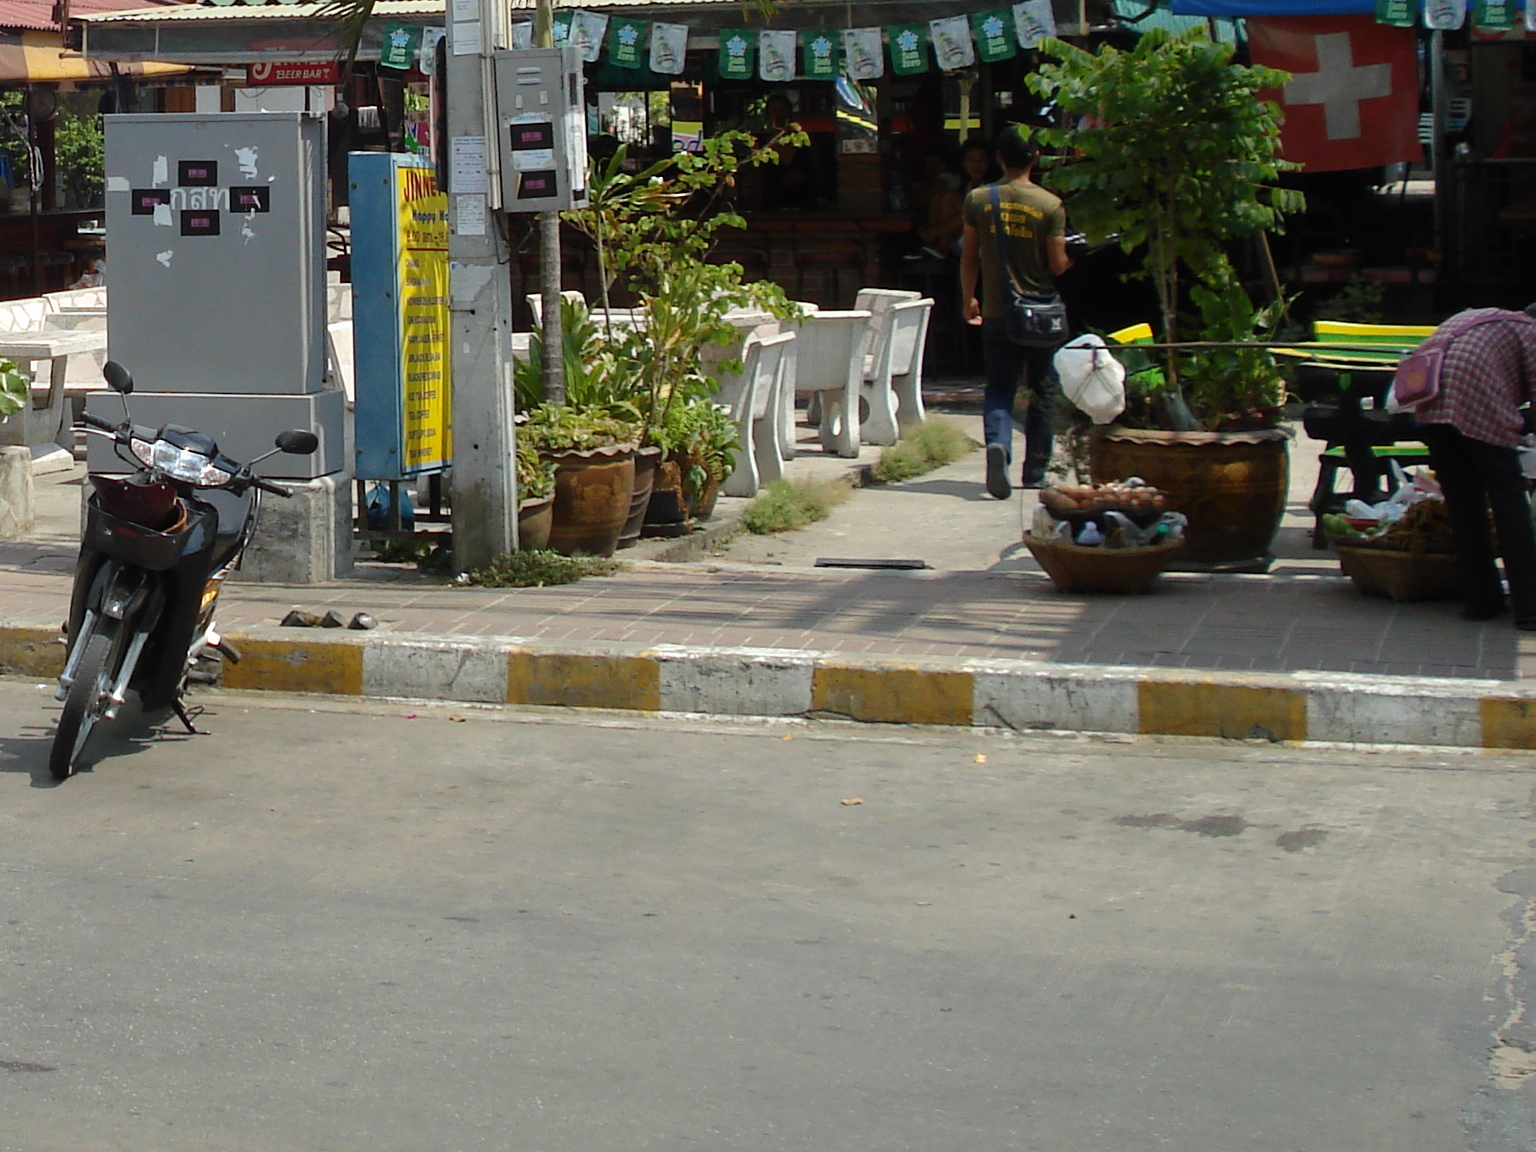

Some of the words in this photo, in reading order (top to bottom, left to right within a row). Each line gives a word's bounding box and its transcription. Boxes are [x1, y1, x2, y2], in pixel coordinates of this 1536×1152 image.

[276, 69, 302, 80] BEER
[303, 68, 322, 79] BAR
[403, 170, 442, 203] JINNE
[170, 186, 230, 210] กสท
[411, 209, 436, 225] Happy
